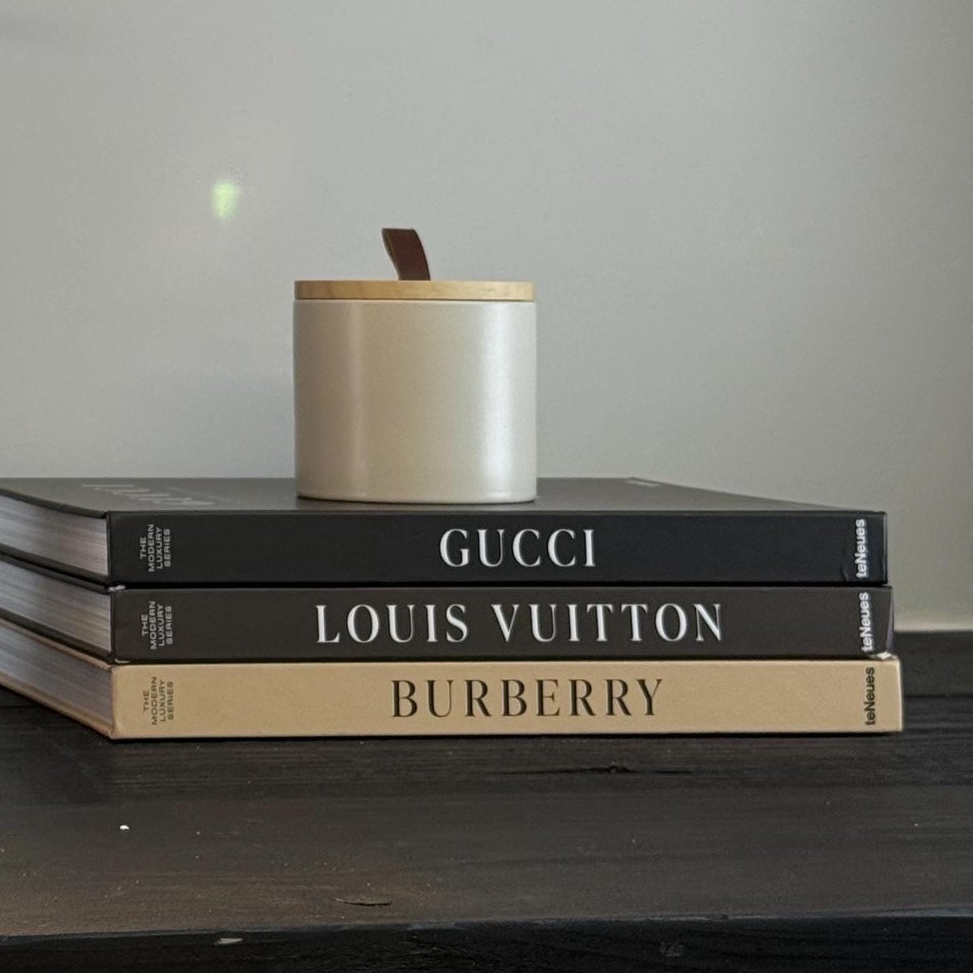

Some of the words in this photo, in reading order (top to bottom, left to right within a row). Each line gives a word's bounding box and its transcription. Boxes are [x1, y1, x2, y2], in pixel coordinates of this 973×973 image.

[139, 537, 147, 559] THE
[147, 523, 155, 573] MODERN
[155, 526, 163, 570] LUXURY
[163, 528, 171, 568] SERIES
[439, 528, 596, 568] GUCCI
[854, 518, 868, 578] teNeues
[148, 600, 157, 650] MODERN
[157, 603, 165, 647] LUXURY
[165, 605, 173, 645] SERIES
[316, 603, 468, 643] LOUIS
[491, 602, 723, 643] VUITTON
[858, 592, 873, 652] teNeues
[150, 676, 158, 726] MODERN
[158, 679, 166, 723] LUXURY
[166, 681, 174, 720] SERIES
[391, 677, 663, 718] BURBERRY
[863, 666, 876, 726] teNeues
